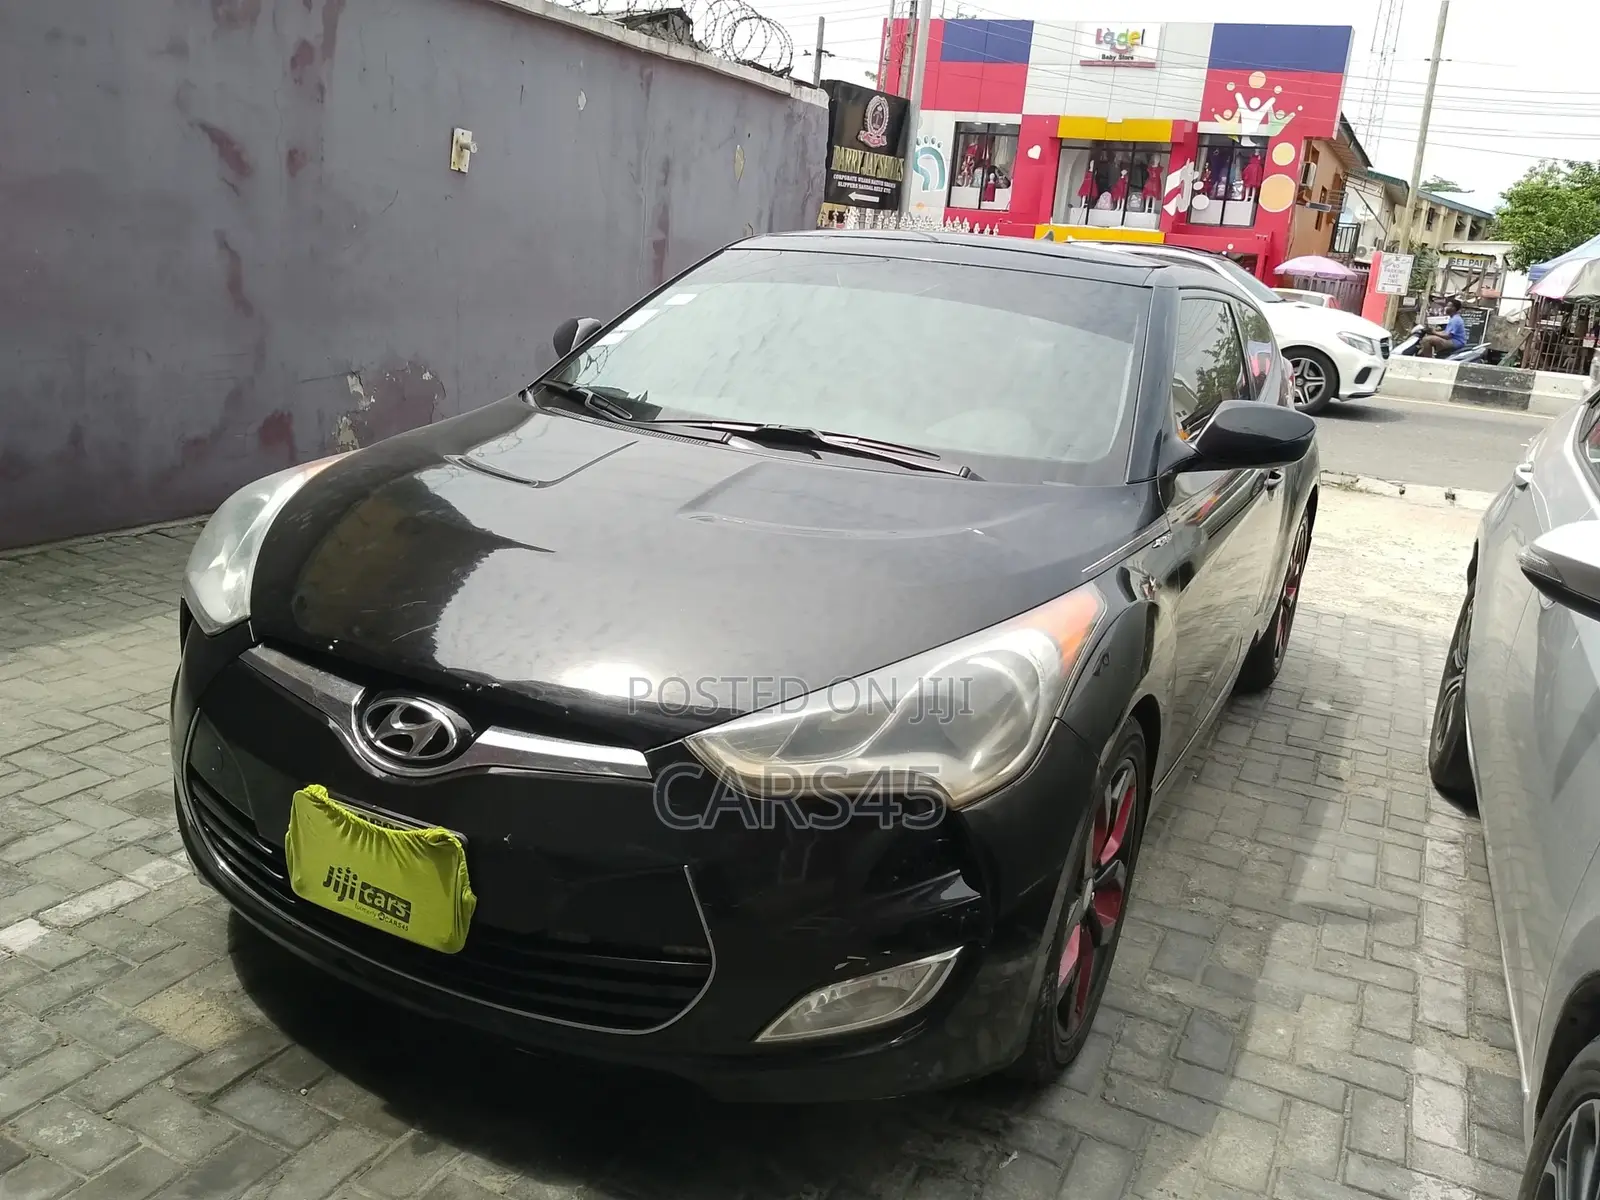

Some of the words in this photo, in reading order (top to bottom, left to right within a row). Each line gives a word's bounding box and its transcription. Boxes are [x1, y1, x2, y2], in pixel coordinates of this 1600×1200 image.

[1101, 54, 1117, 62] Baby
[838, 181, 858, 189] SLIPPERS
[362, 885, 409, 919] cars
[384, 917, 409, 932] CARS45
